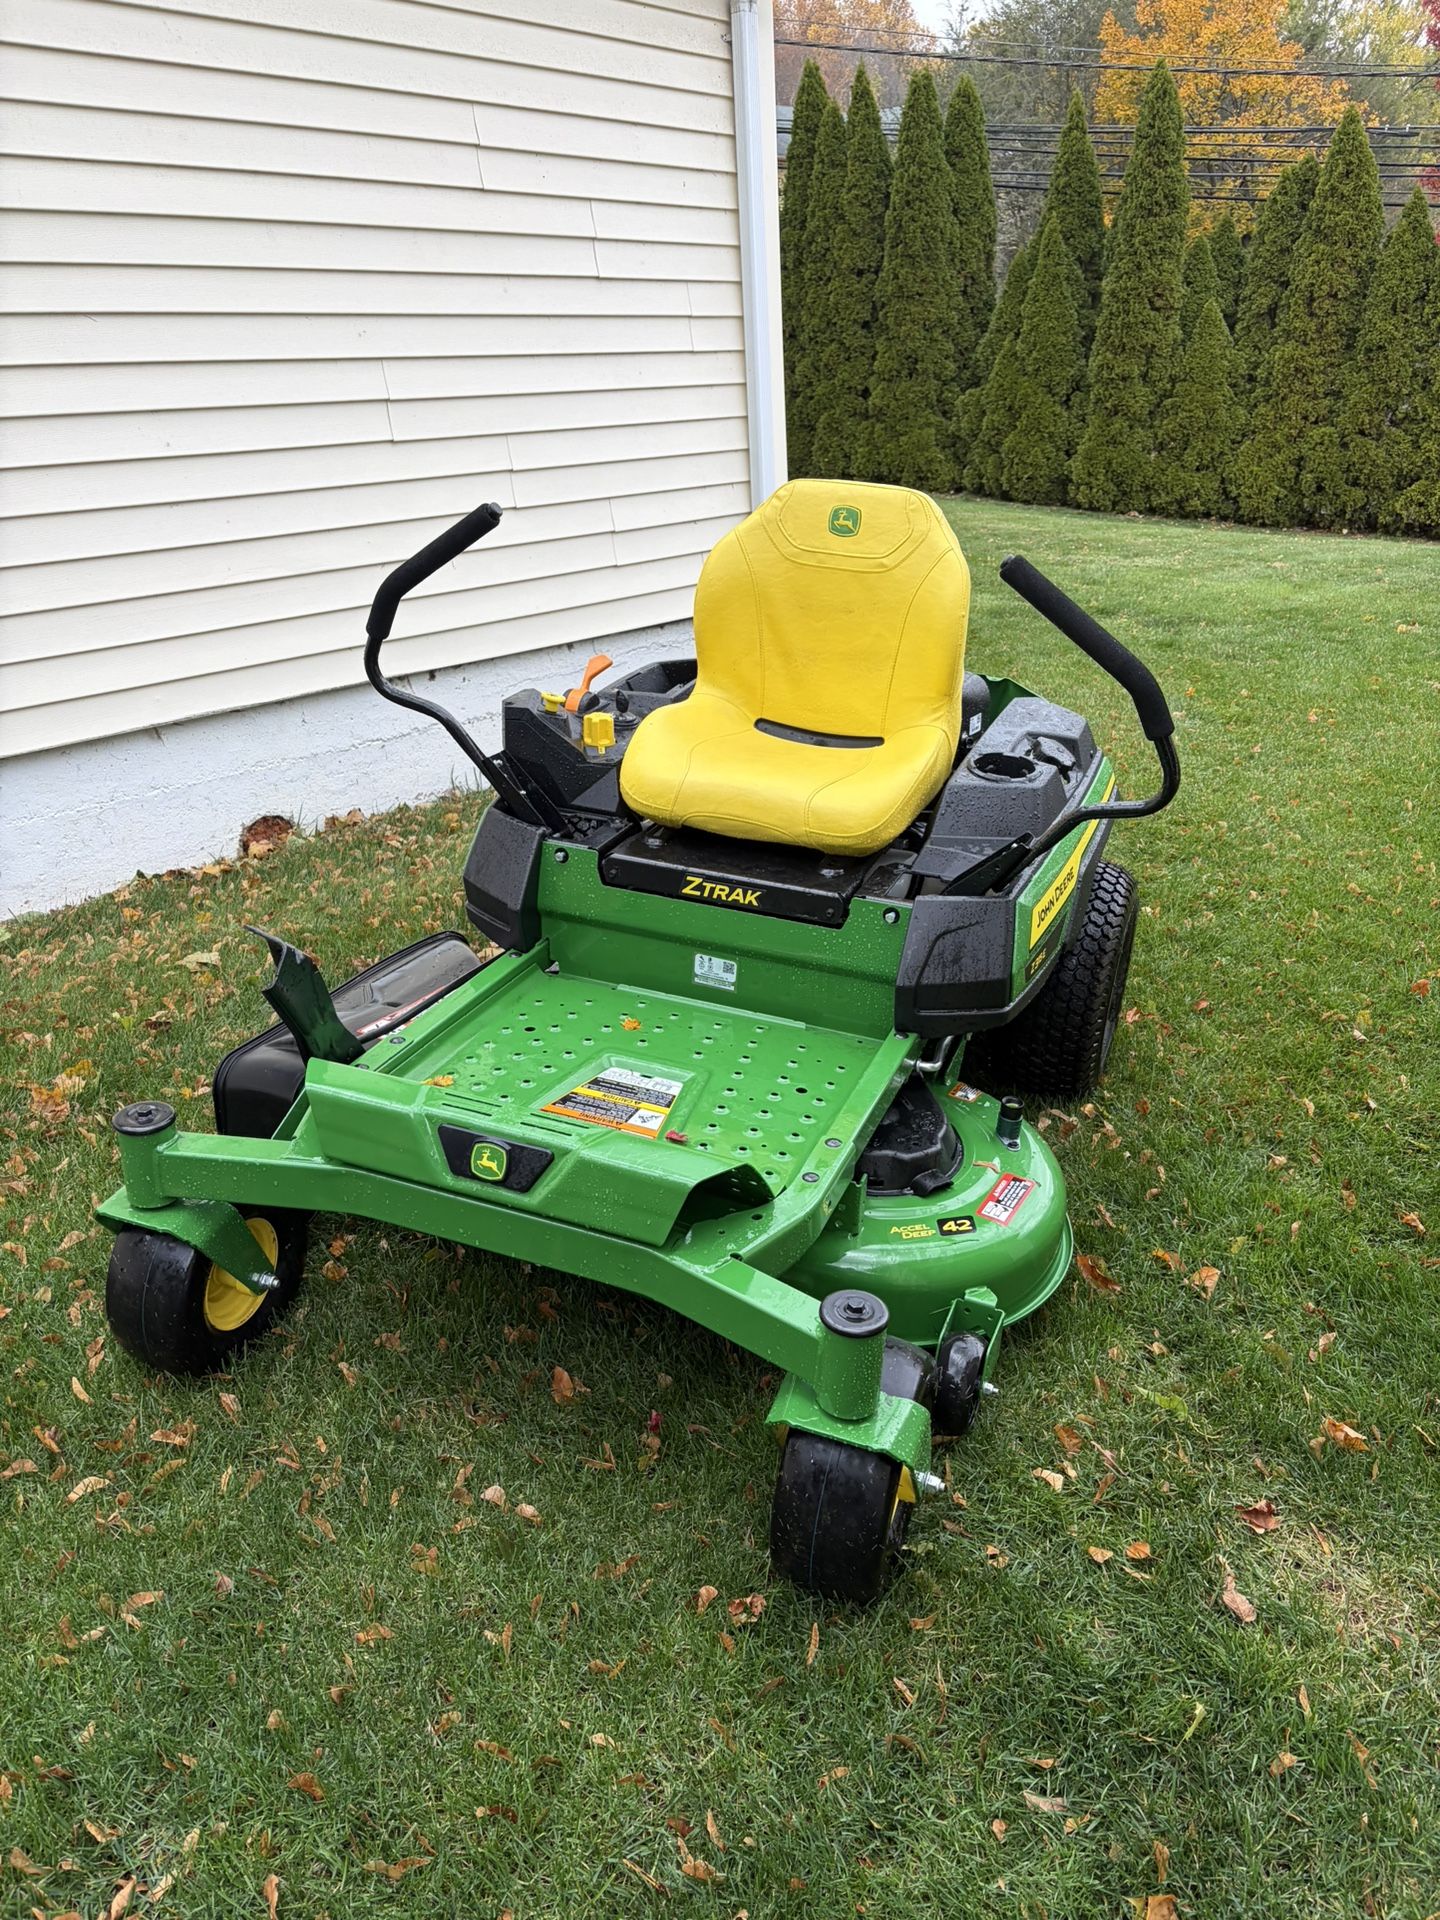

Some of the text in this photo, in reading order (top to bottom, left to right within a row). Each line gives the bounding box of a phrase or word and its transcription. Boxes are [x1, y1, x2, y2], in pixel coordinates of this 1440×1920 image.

[681, 875, 762, 907] ZTRAK
[1036, 866, 1075, 929] JOHN DEERE
[601, 1093, 634, 1105] CAUTION
[890, 1223, 931, 1234] ACCEL
[942, 1219, 973, 1232] 42
[902, 1229, 936, 1240] DEEP
